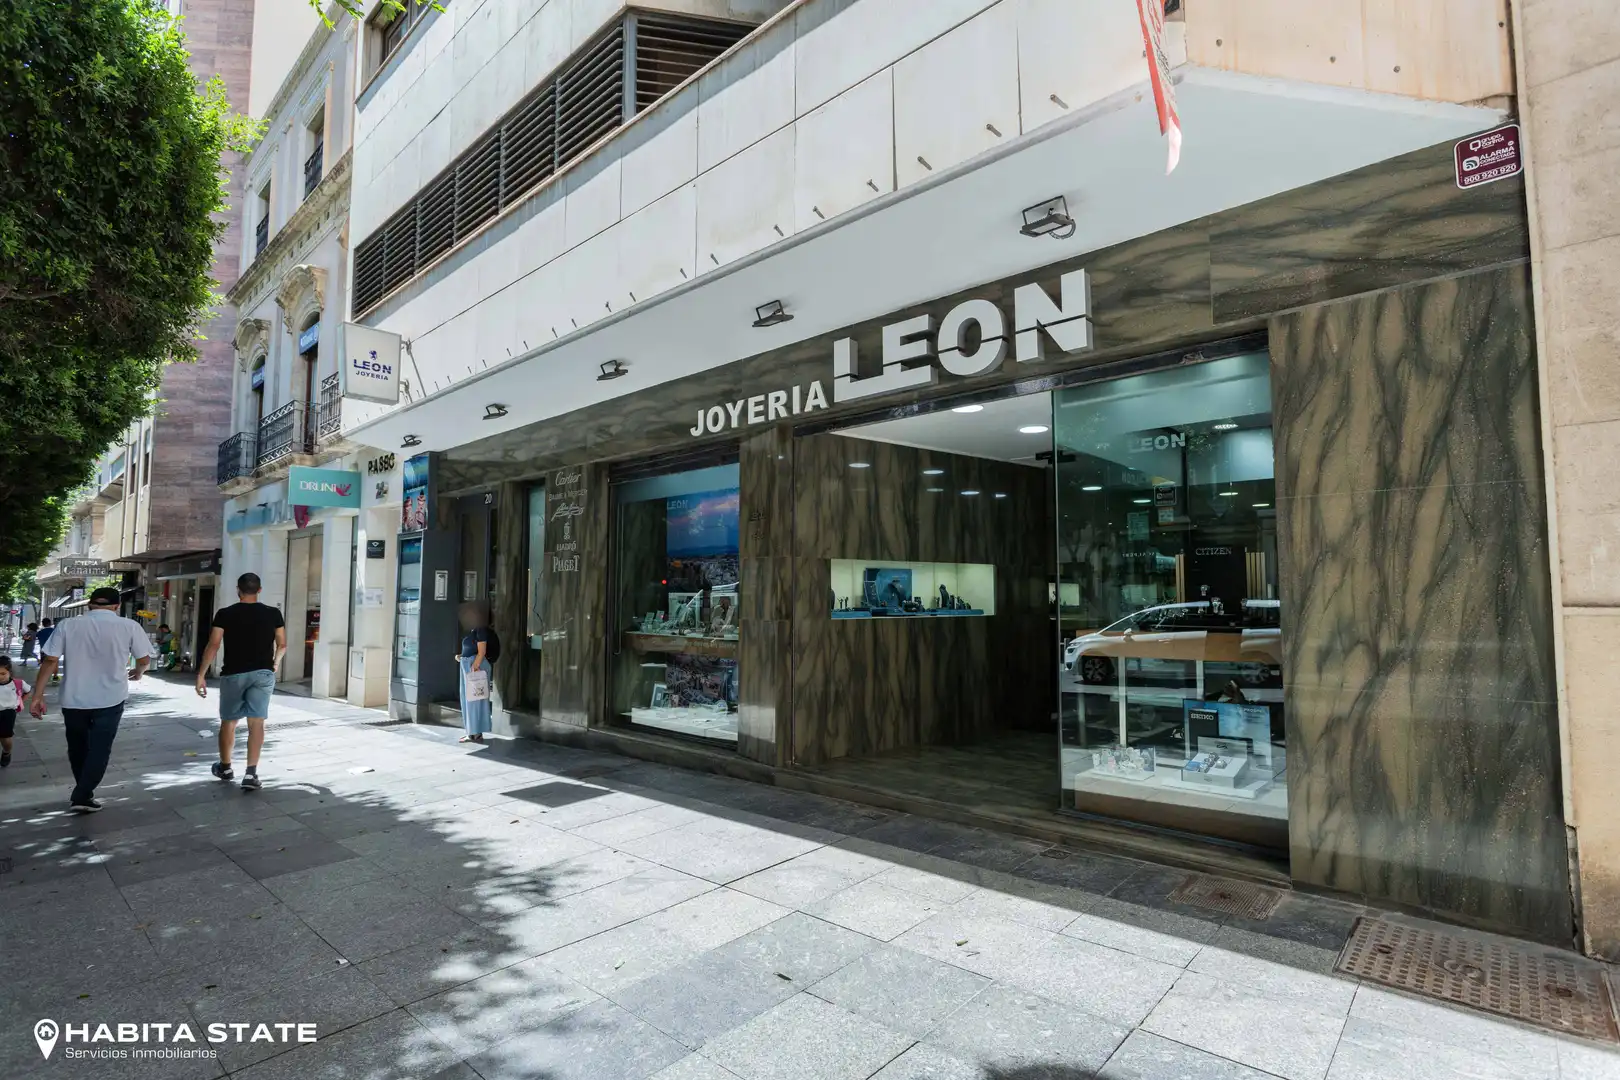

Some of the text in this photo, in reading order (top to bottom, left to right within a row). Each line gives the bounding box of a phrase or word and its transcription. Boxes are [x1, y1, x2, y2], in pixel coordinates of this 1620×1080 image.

[1480, 146, 1514, 160] ALARMA
[1480, 151, 1515, 165] CONECTADA
[1464, 163, 1516, 185] 900 920 920
[690, 268, 1093, 437] JOYERIA LEON
[353, 359, 392, 374] LEON
[356, 370, 389, 380] JOYERIA
[1127, 432, 1186, 453] LEON
[555, 471, 582, 486] Cartier
[300, 481, 336, 493] DRUNI
[485, 493, 492, 504] 20
[667, 500, 688, 510] LEON
[1195, 547, 1232, 556] CITIZEN
[63, 566, 107, 575] Canaima
[553, 555, 580, 572] PIAGET
[1190, 713, 1214, 721] SEIKO
